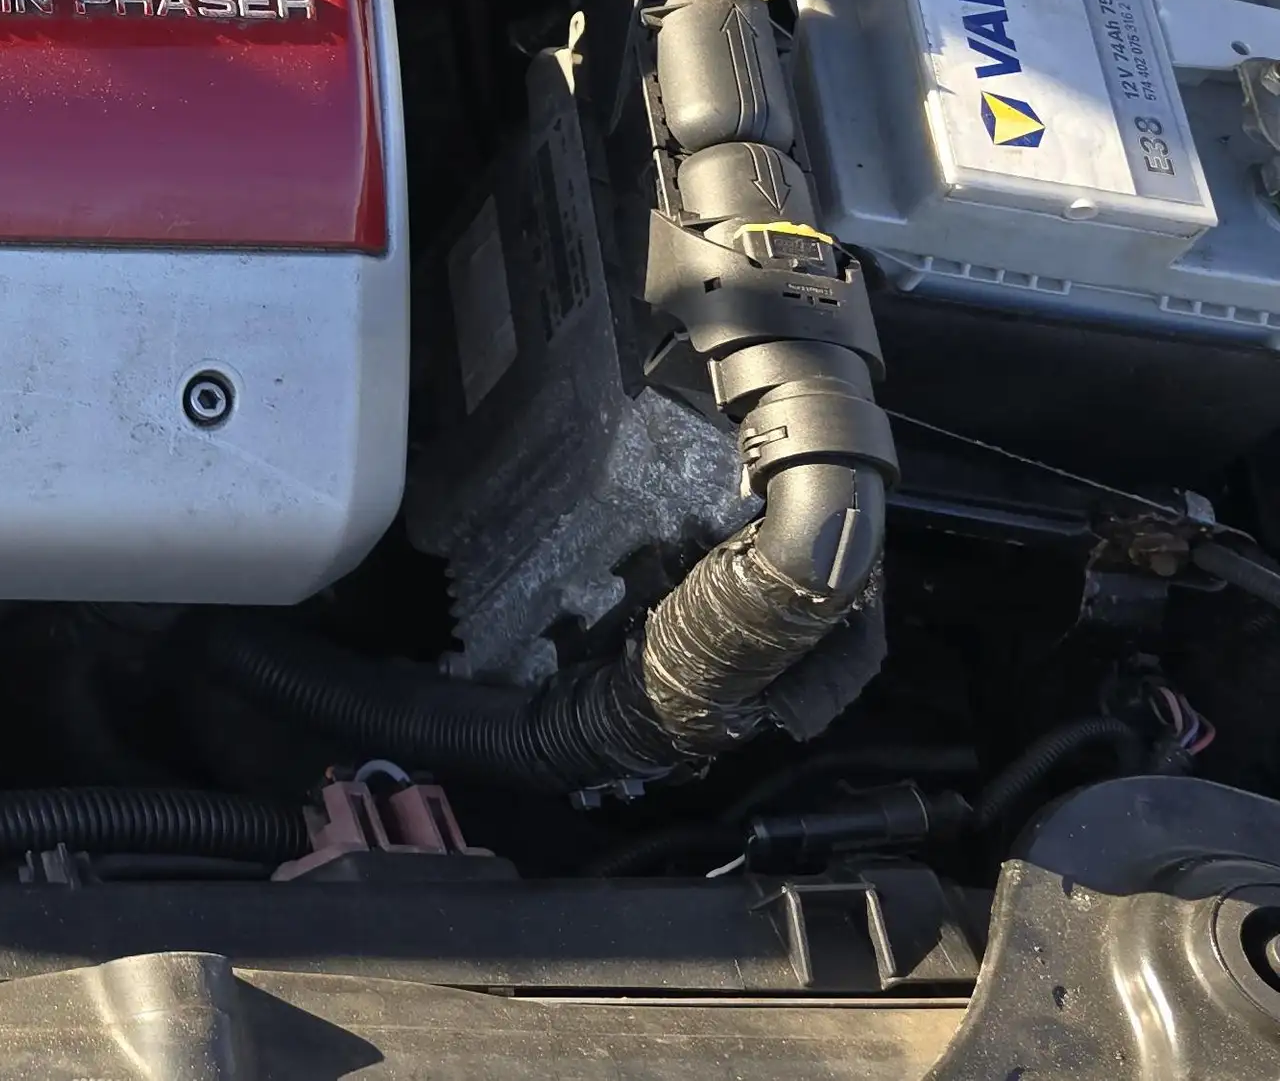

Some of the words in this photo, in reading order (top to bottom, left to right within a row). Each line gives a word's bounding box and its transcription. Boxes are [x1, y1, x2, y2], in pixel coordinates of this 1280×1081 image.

[1105, 20, 1128, 62] 74Ah
[1134, 56, 1149, 78] 402
[1141, 81, 1157, 101] 574
[1134, 115, 1175, 176] E38
